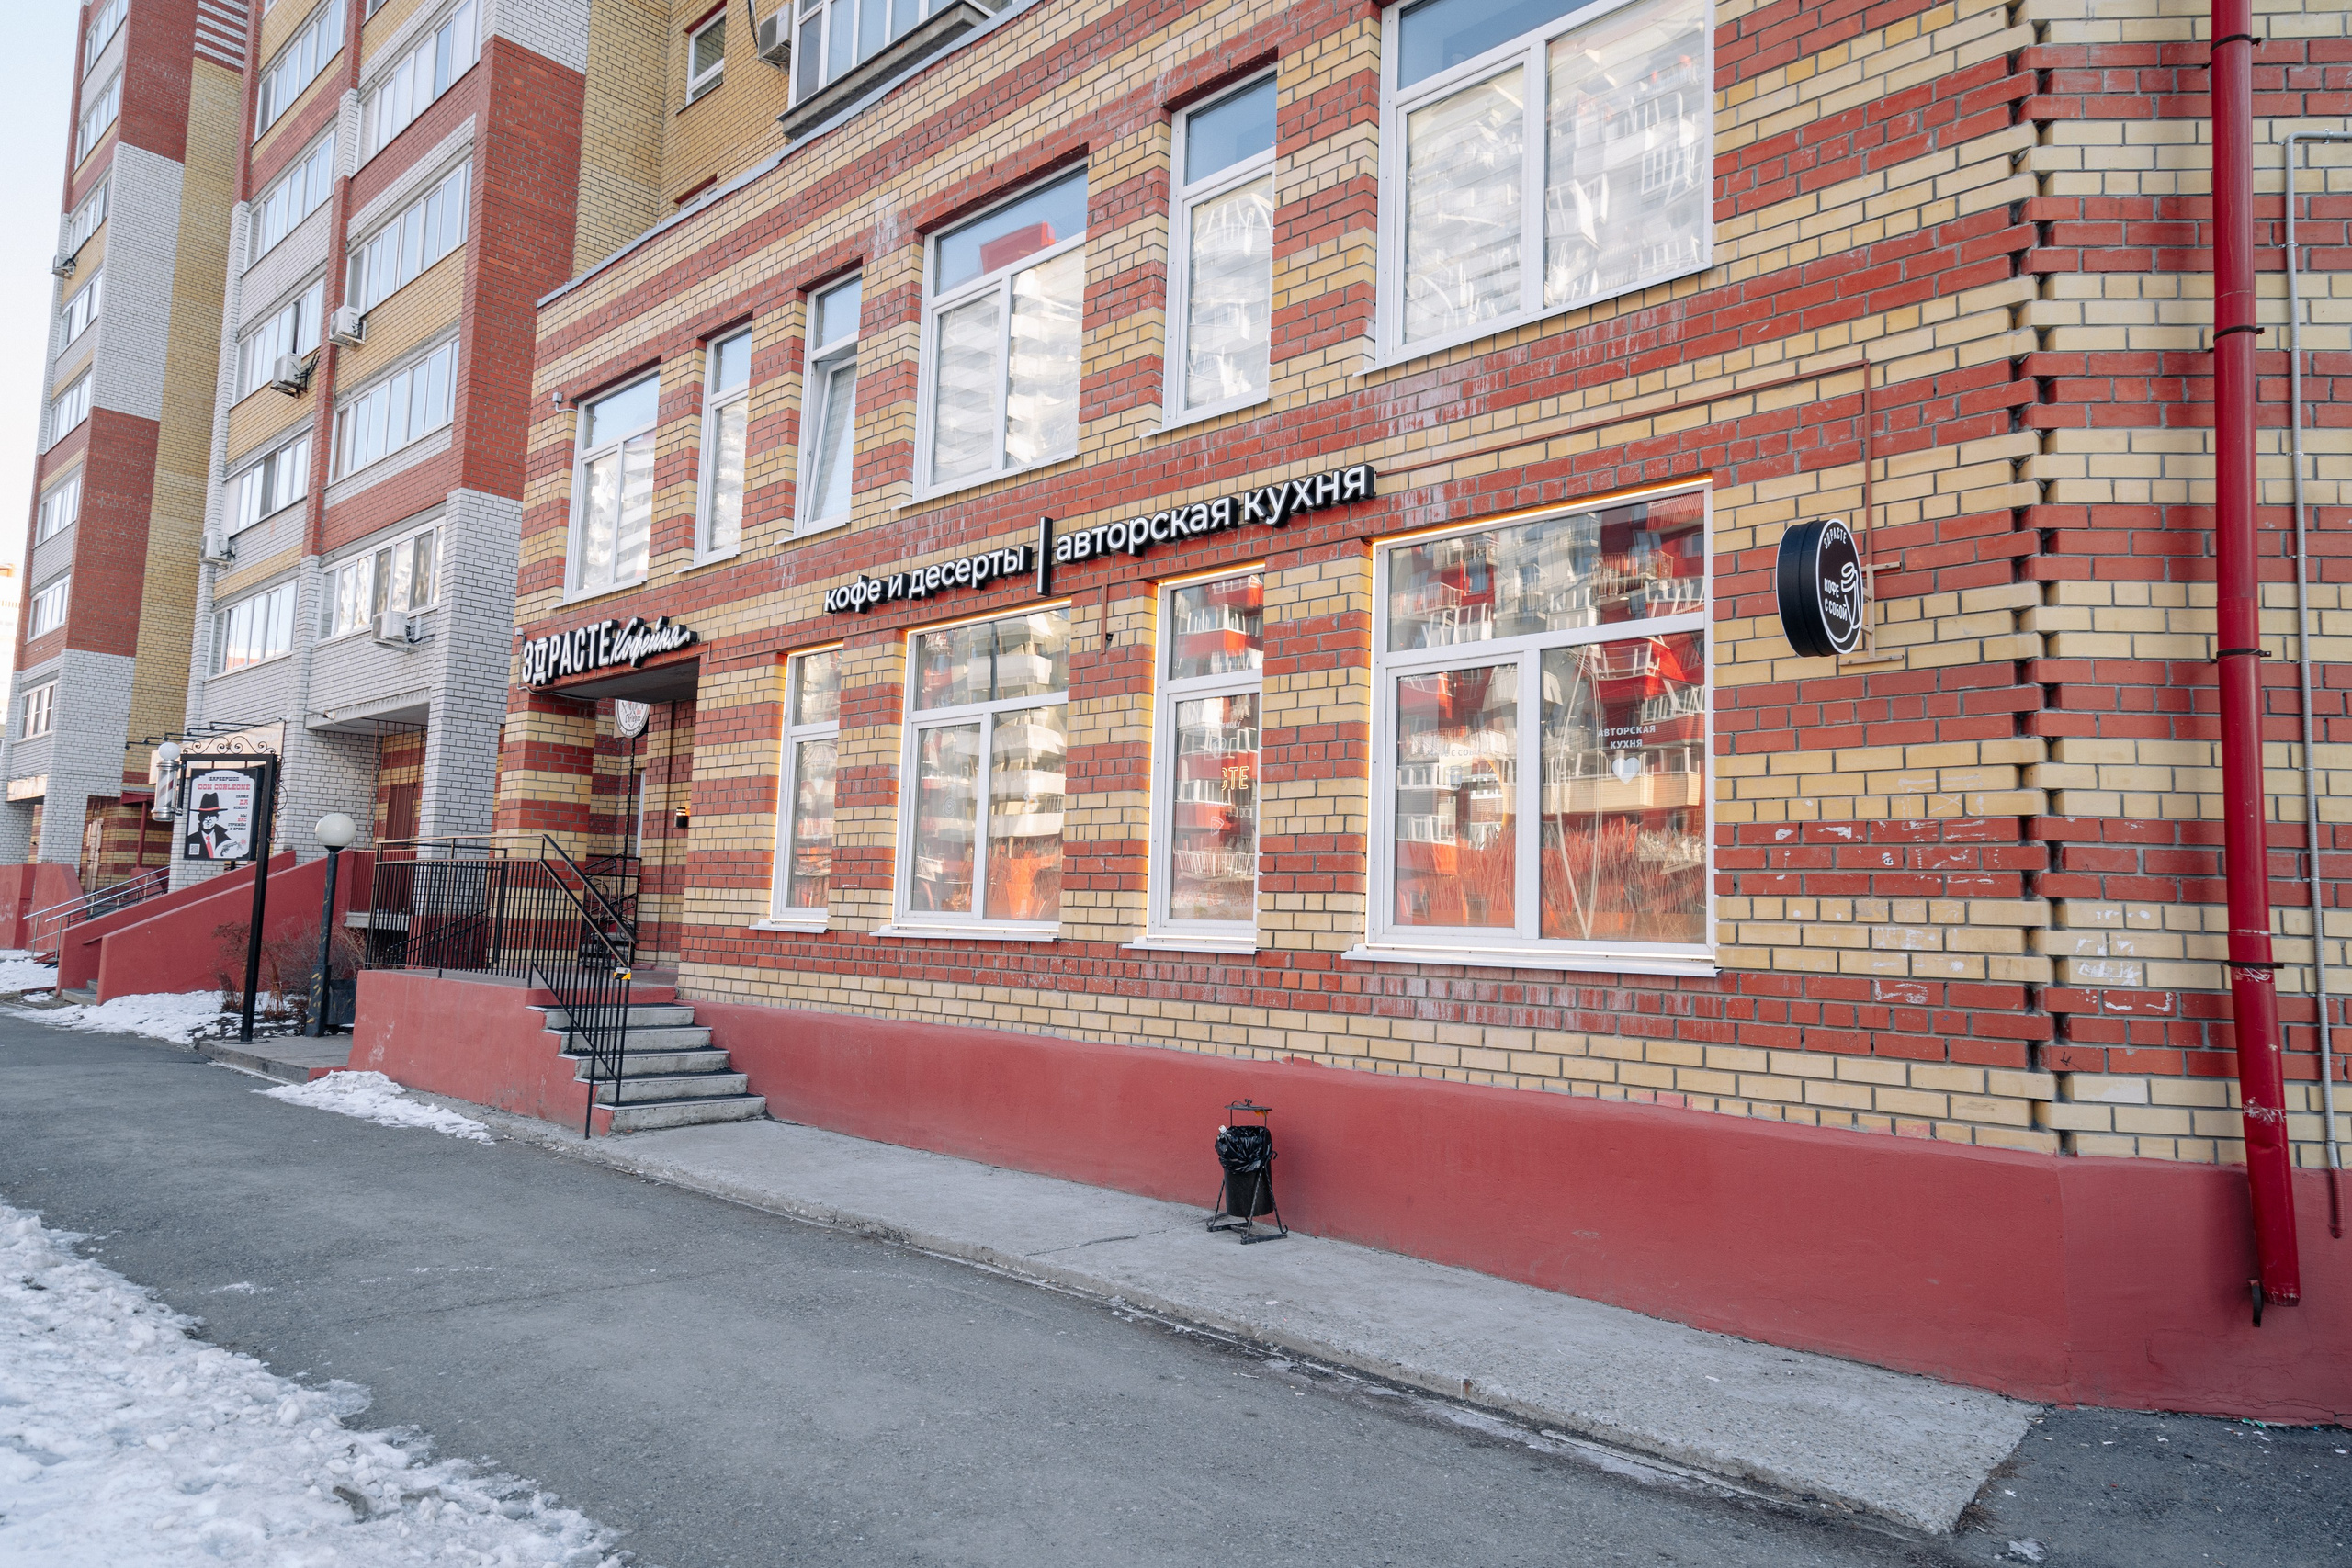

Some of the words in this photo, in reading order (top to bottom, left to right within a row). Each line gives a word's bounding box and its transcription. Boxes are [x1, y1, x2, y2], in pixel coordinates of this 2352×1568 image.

[824, 575, 882, 612] кофе
[888, 573, 906, 598] и
[909, 546, 1026, 600] десерты
[1057, 497, 1233, 555] авторская
[1243, 465, 1370, 526] кухня
[1824, 526, 1847, 549] ЗДРАСТЕ
[1824, 578, 1839, 598] КОФЕ
[1825, 598, 1828, 612] С
[1828, 602, 1848, 621] СОБОЙ
[522, 619, 614, 686] ЗДРАСТЕ
[1598, 724, 1656, 738] АВТОРСКАЯ
[1610, 739, 1643, 750] КУХНЯ
